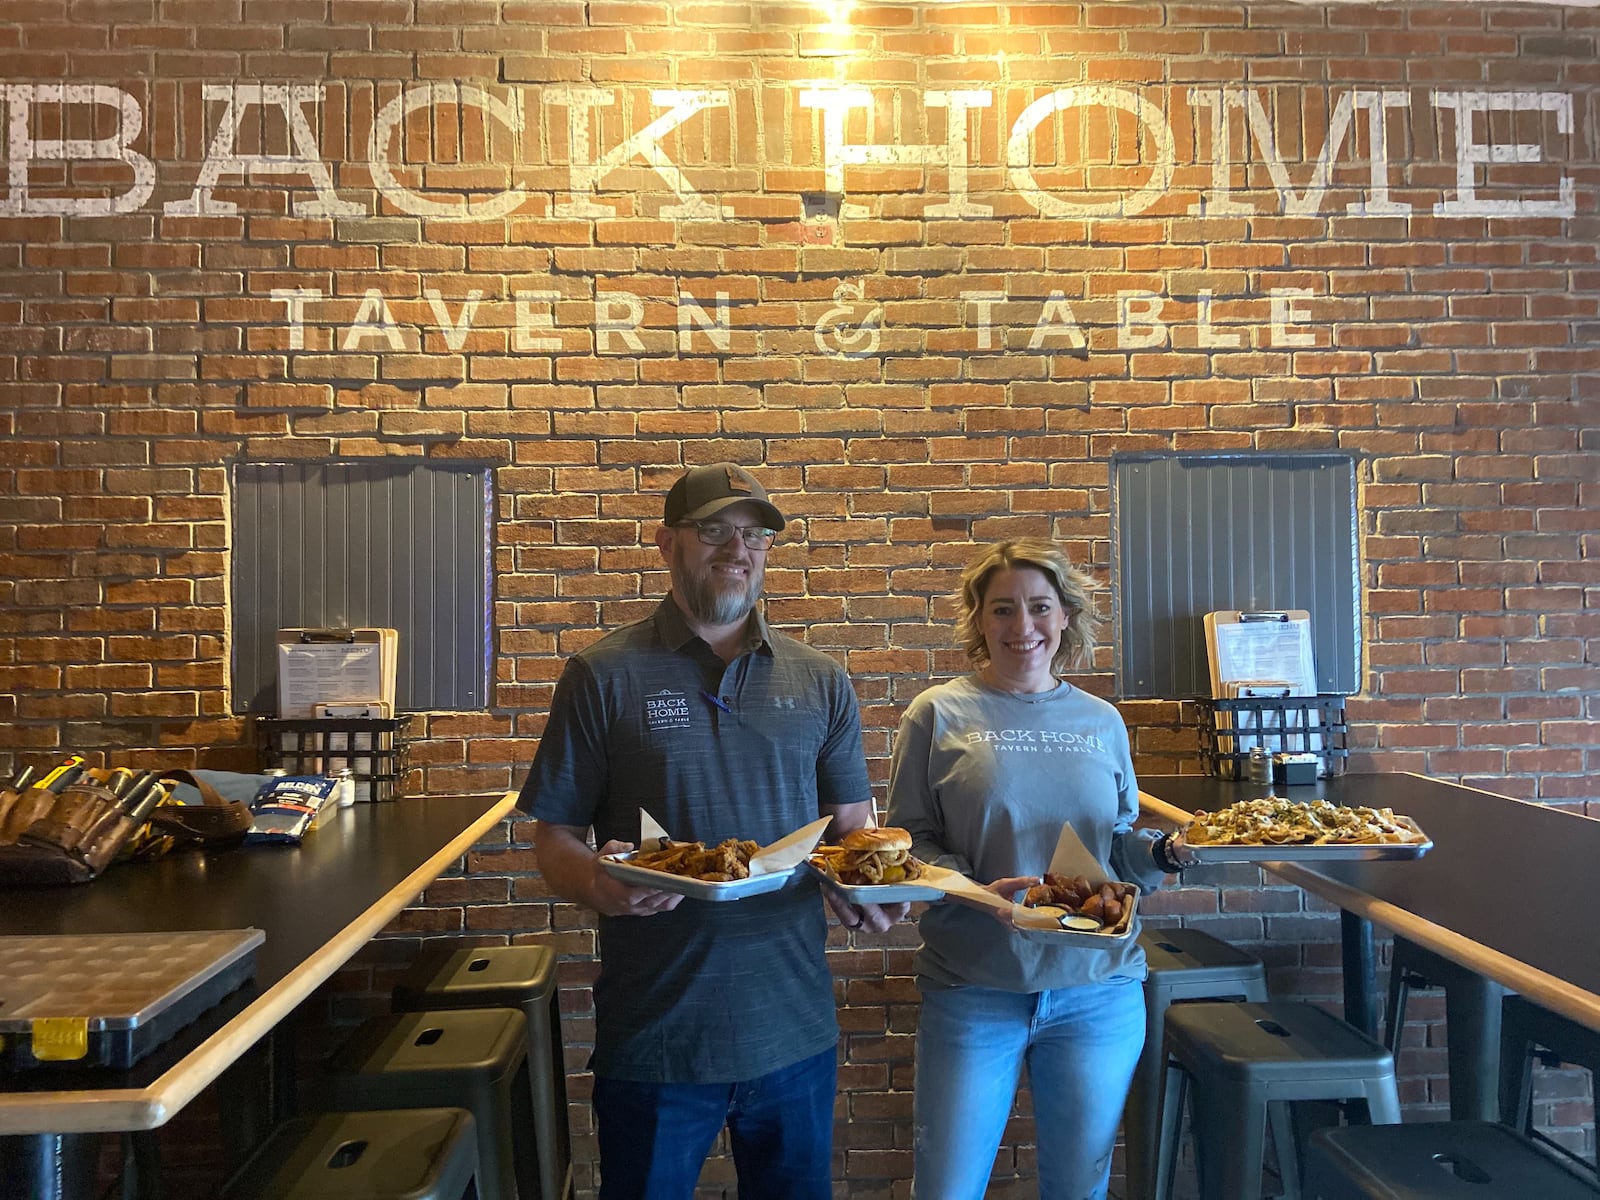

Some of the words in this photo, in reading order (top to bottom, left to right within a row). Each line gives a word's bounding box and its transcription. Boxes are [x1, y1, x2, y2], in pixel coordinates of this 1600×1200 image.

[0, 83, 735, 221] BACK
[799, 83, 1577, 220] HOME
[270, 287, 731, 354] TAVERN
[813, 281, 882, 360] &
[959, 286, 1317, 351] TABLE
[647, 698, 687, 709] BACK
[647, 707, 689, 718] HOME
[965, 729, 1036, 745] BACK
[993, 744, 1038, 753] TAVERN
